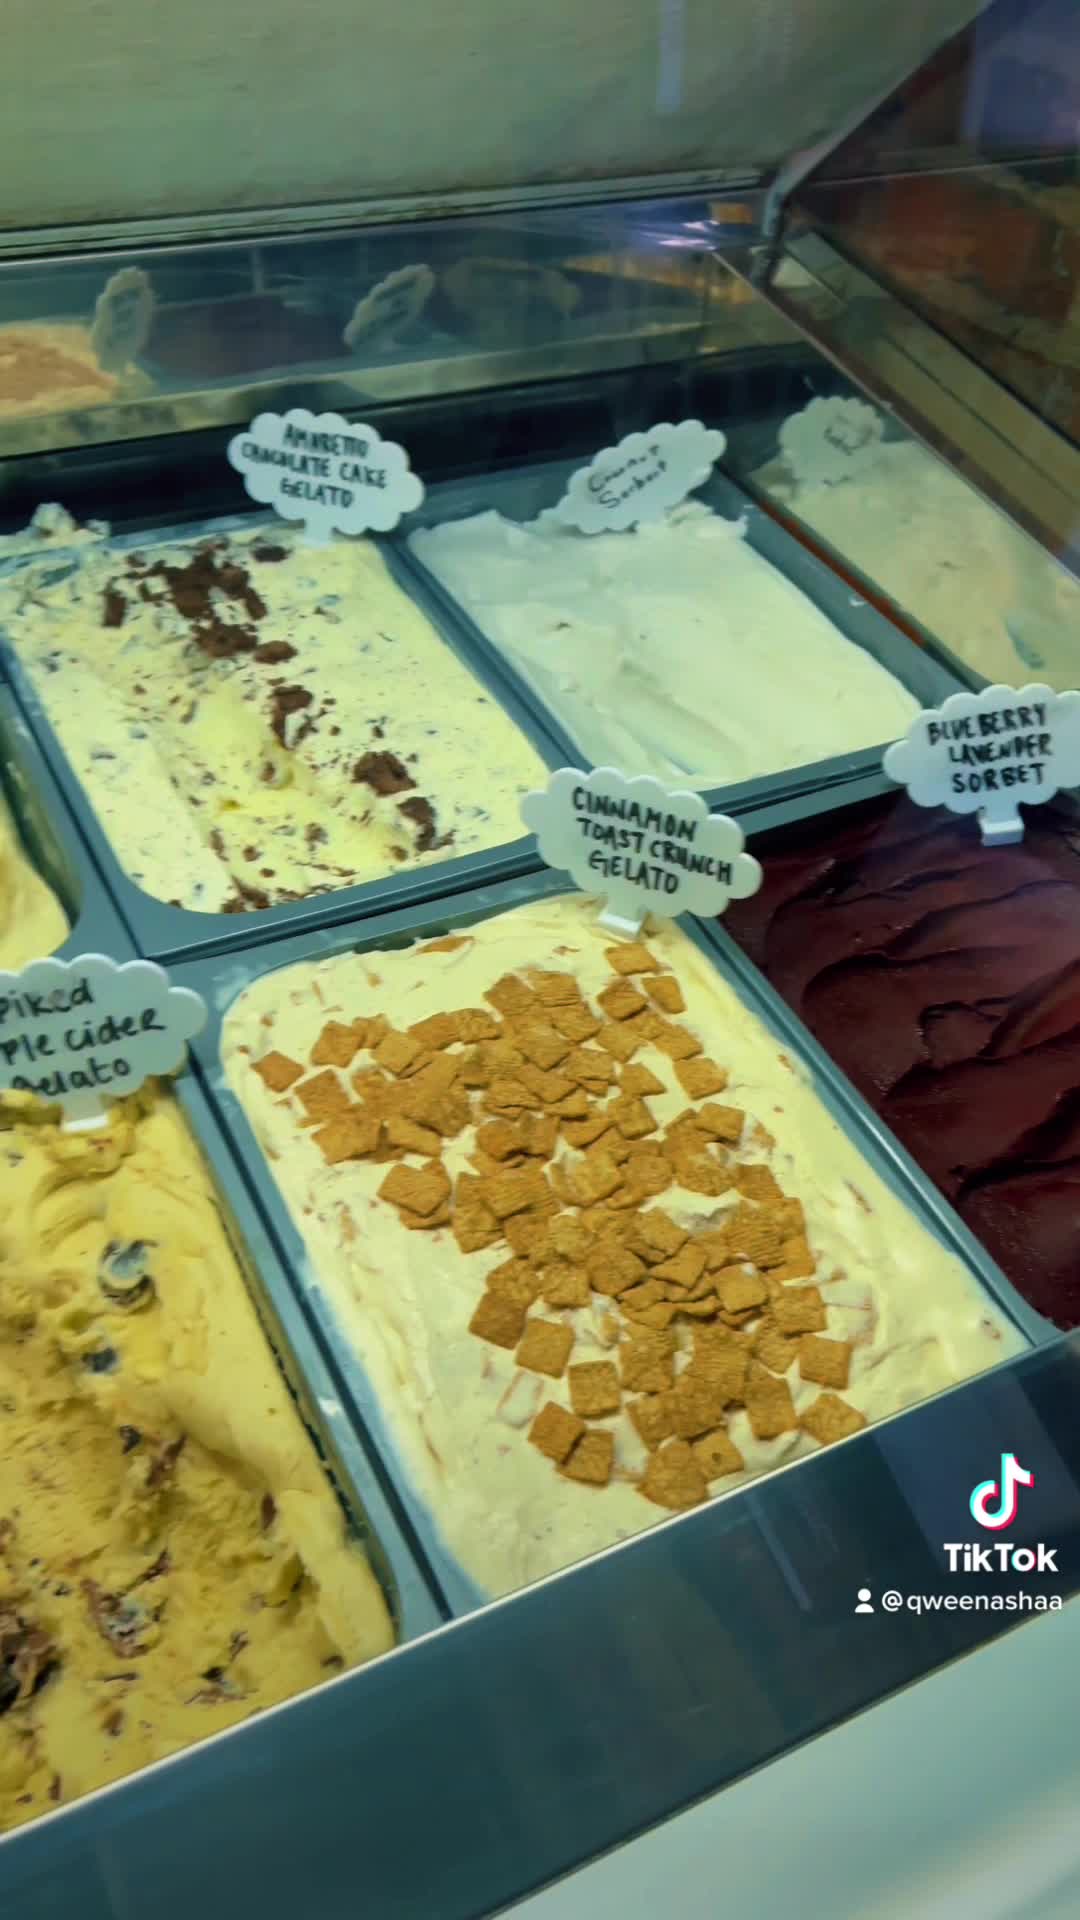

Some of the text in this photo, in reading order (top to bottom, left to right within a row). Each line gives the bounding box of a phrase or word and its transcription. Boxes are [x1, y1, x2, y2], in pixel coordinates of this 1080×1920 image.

[279, 477, 355, 509] GELATO
[339, 461, 388, 489] CAKE
[926, 703, 1047, 746] BLUEBERRY
[948, 733, 1053, 766] LAVENDER
[951, 763, 1046, 793] SORBET
[572, 786, 698, 842] CINNAMON
[576, 817, 733, 886] TOAST CRUNCH
[588, 850, 680, 895] GELATO
